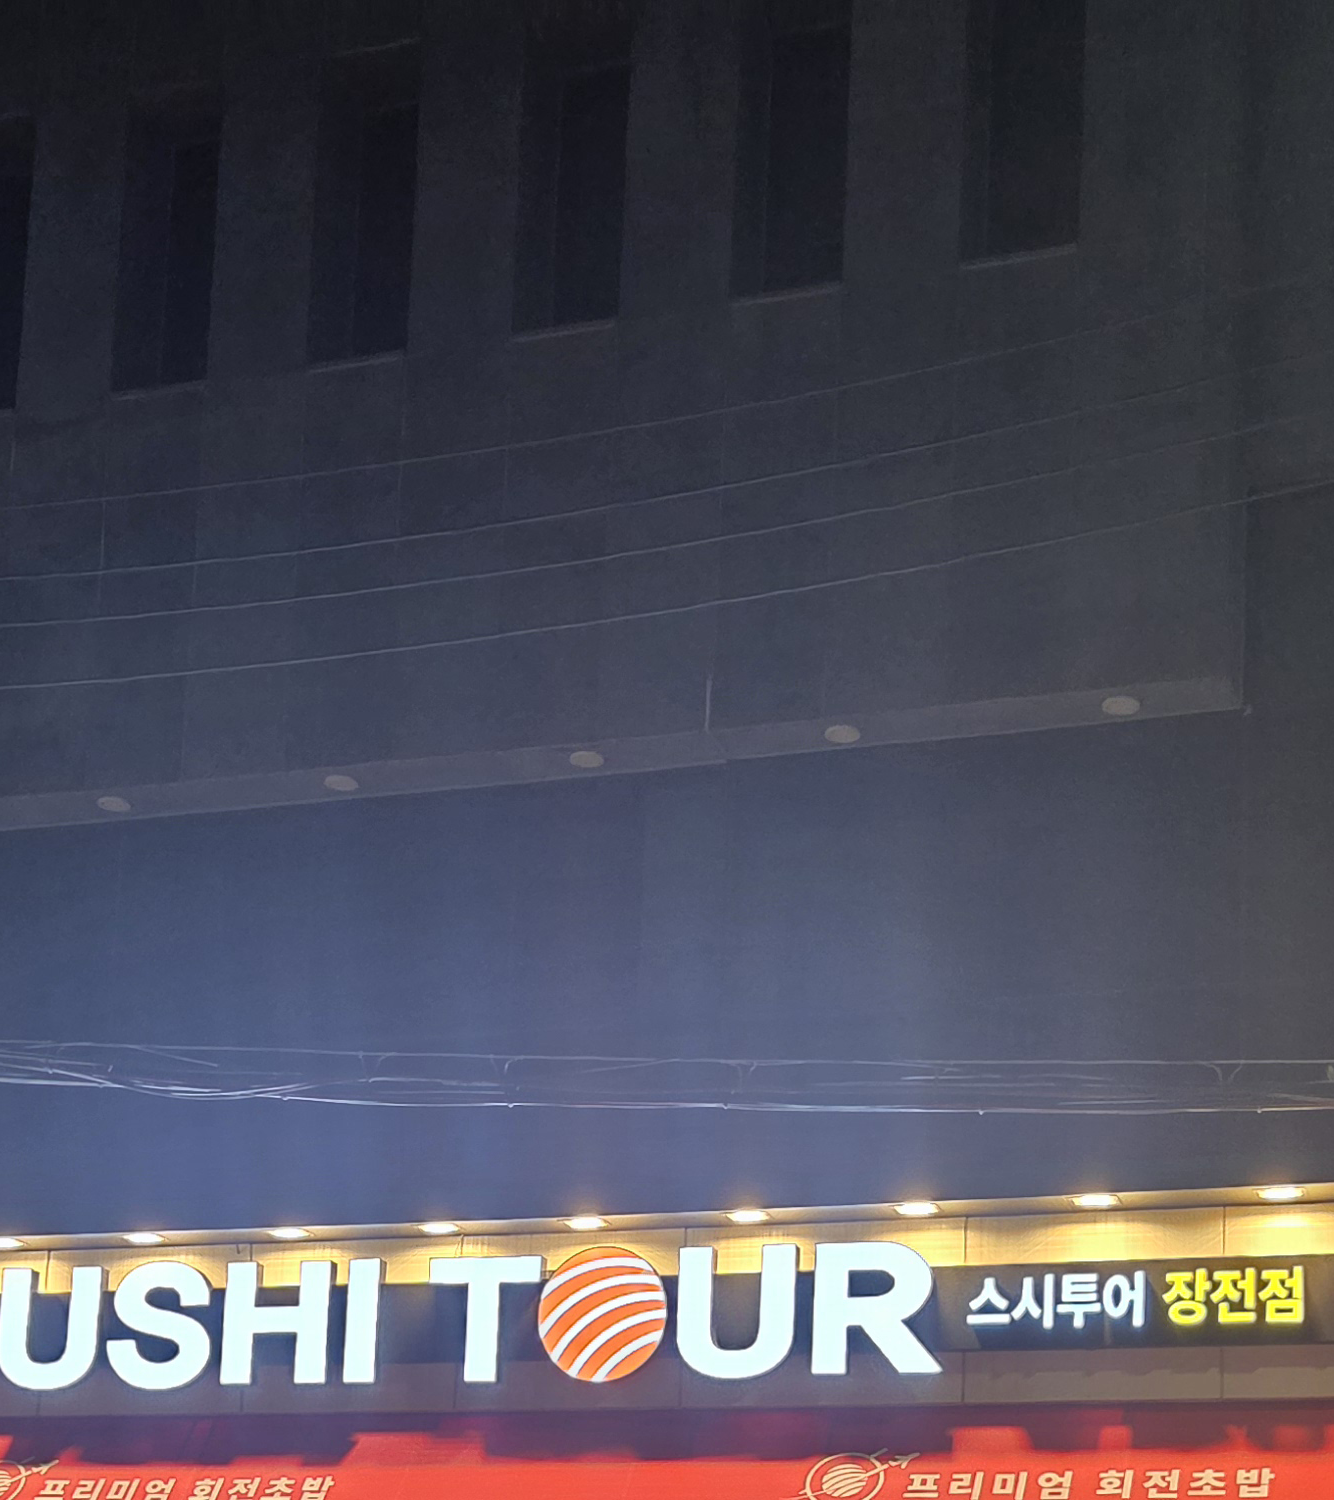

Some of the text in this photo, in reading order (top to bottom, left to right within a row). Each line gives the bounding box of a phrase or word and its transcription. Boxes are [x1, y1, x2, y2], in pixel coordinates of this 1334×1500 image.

[429, 1241, 942, 1384] TOUR
[966, 1265, 1305, 1329] 스시투어 장전점
[902, 1466, 1276, 1500] 프리미엄 회전초밥
